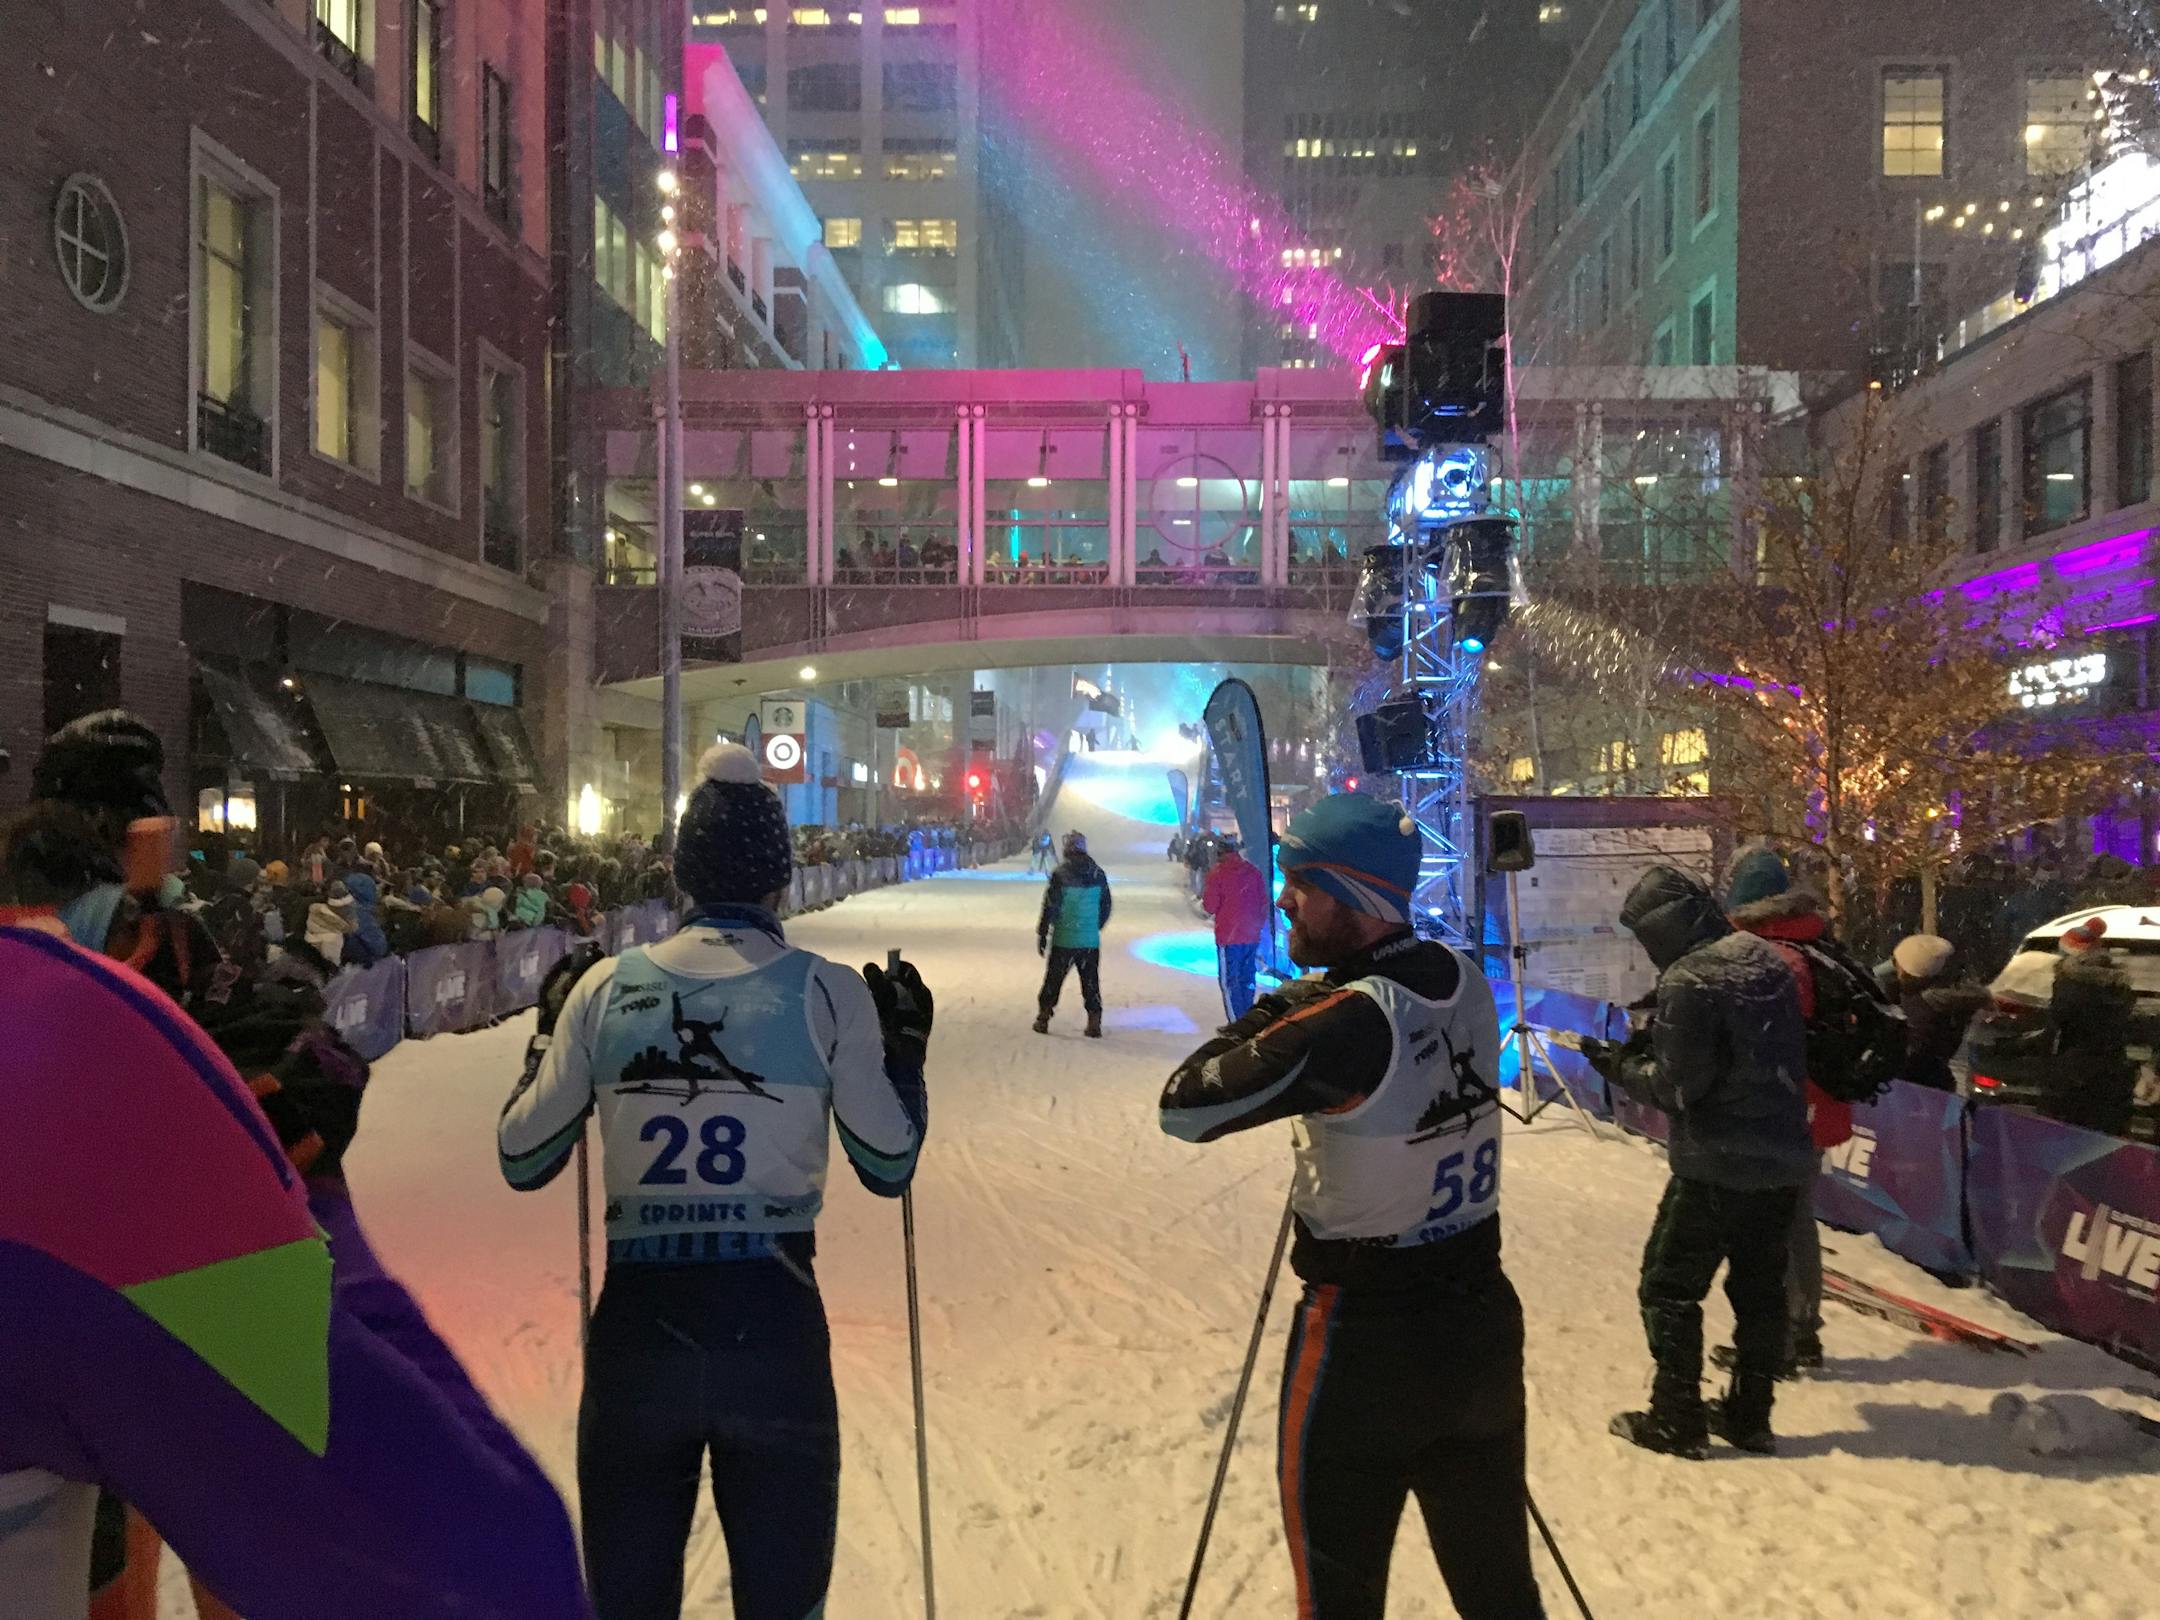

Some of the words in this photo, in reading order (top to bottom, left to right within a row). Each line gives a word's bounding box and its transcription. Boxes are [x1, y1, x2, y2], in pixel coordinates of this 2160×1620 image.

[638, 1114, 748, 1186] 28
[1426, 1136, 1500, 1223] 58
[639, 1202, 747, 1225] SPRINTS
